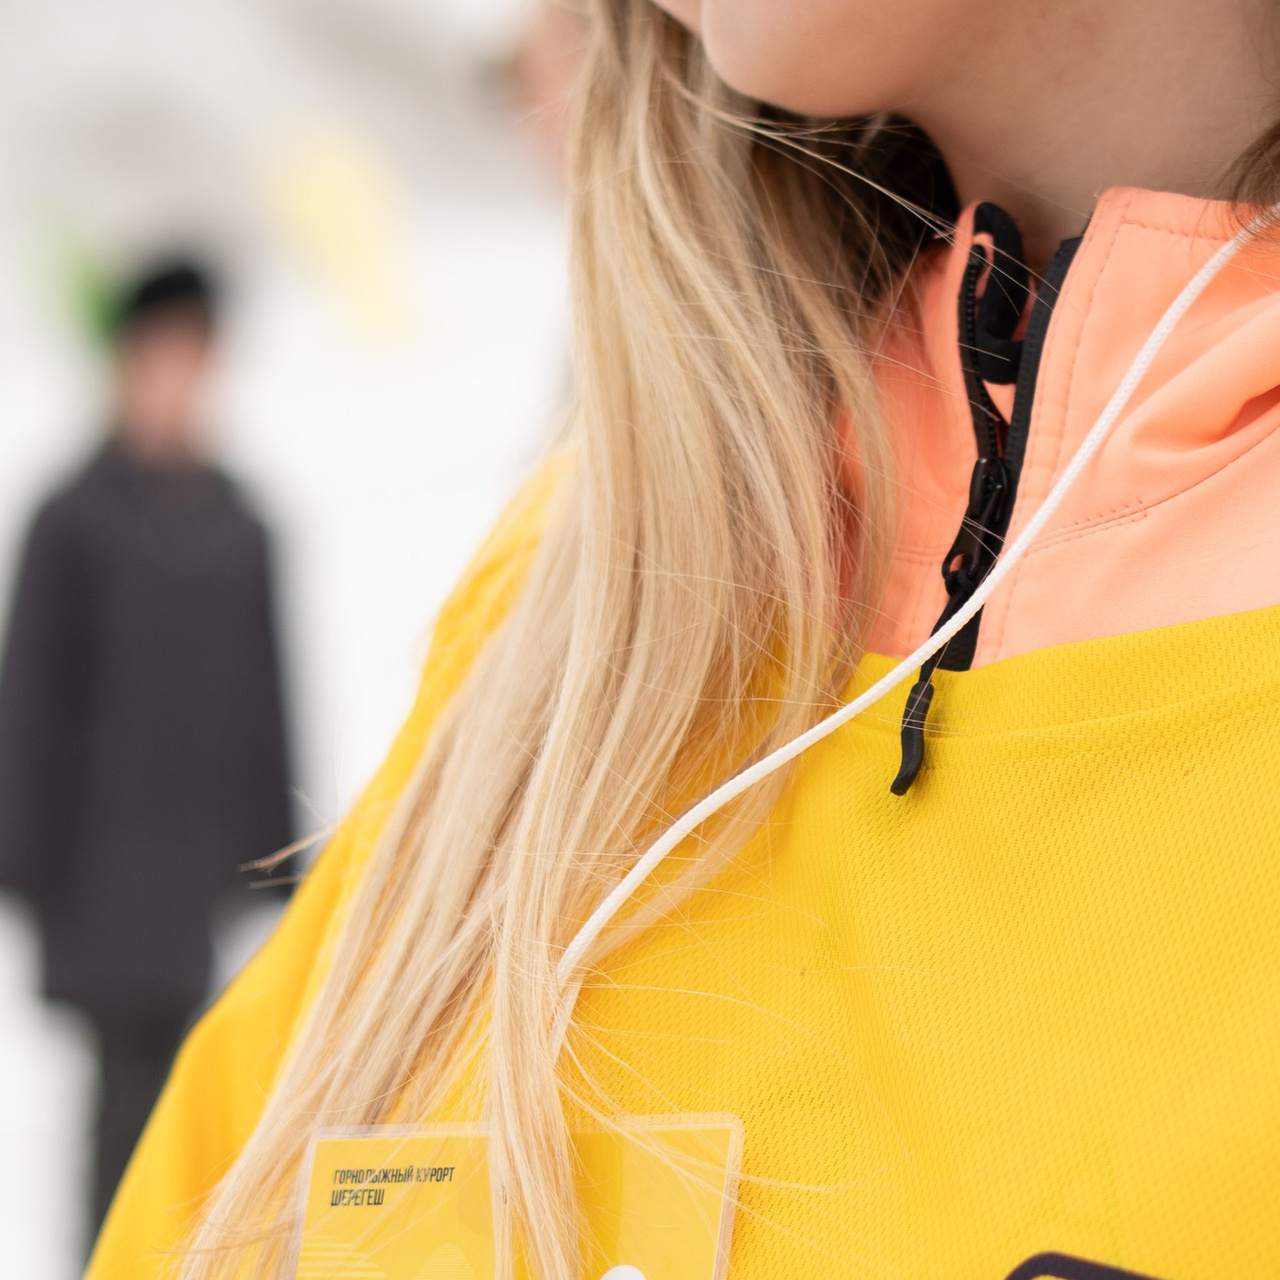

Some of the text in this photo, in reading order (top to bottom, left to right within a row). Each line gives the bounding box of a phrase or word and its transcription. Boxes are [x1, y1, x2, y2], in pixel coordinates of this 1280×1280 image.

[333, 1165, 455, 1185] ГОРНОЛЫЖНЫЙ КУРОРТ
[330, 1188, 385, 1207] ШЕРЕГЕШ
